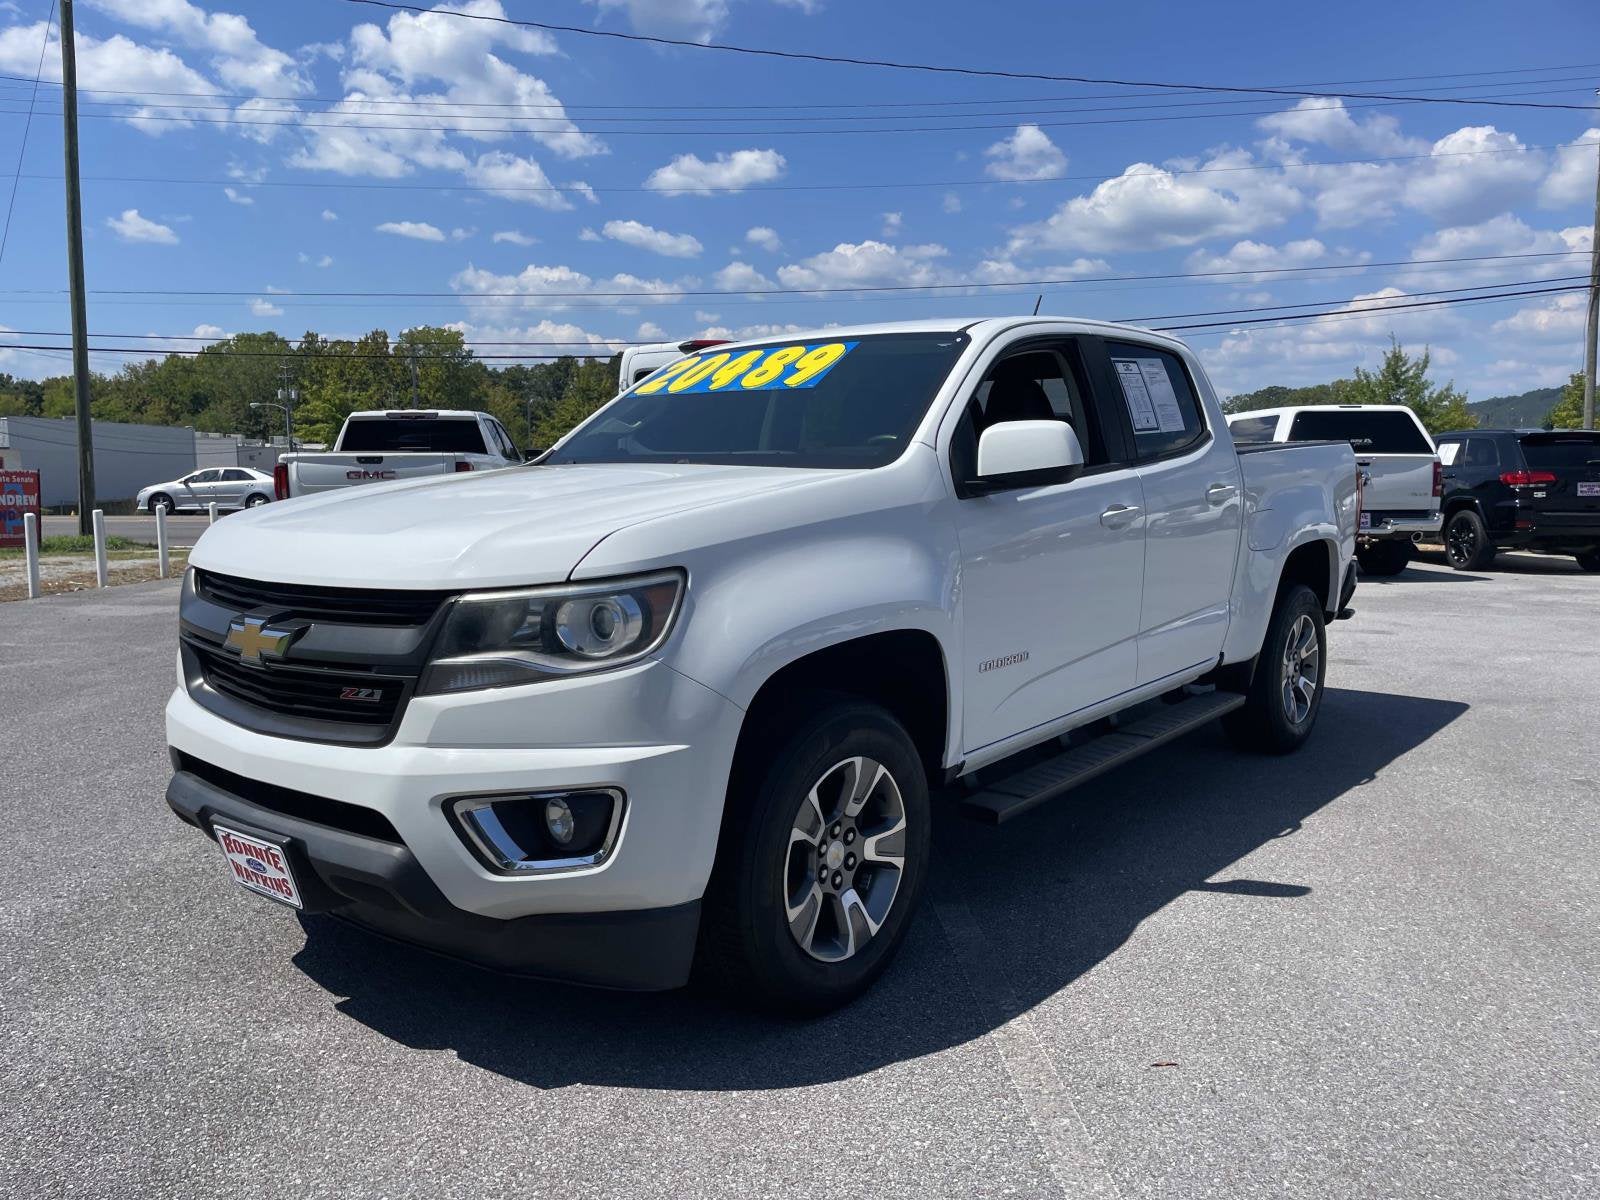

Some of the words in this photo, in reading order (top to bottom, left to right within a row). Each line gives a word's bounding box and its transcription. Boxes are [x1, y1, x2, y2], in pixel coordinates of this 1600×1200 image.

[634, 343, 846, 395] 20489
[11, 475, 34, 483] Senate
[346, 470, 396, 480] GMC
[0, 494, 38, 506] NDREW
[978, 650, 1029, 673] COLORADO
[340, 687, 382, 701] Z71
[221, 834, 285, 874] RONNIE
[230, 858, 293, 897] WATKINS
